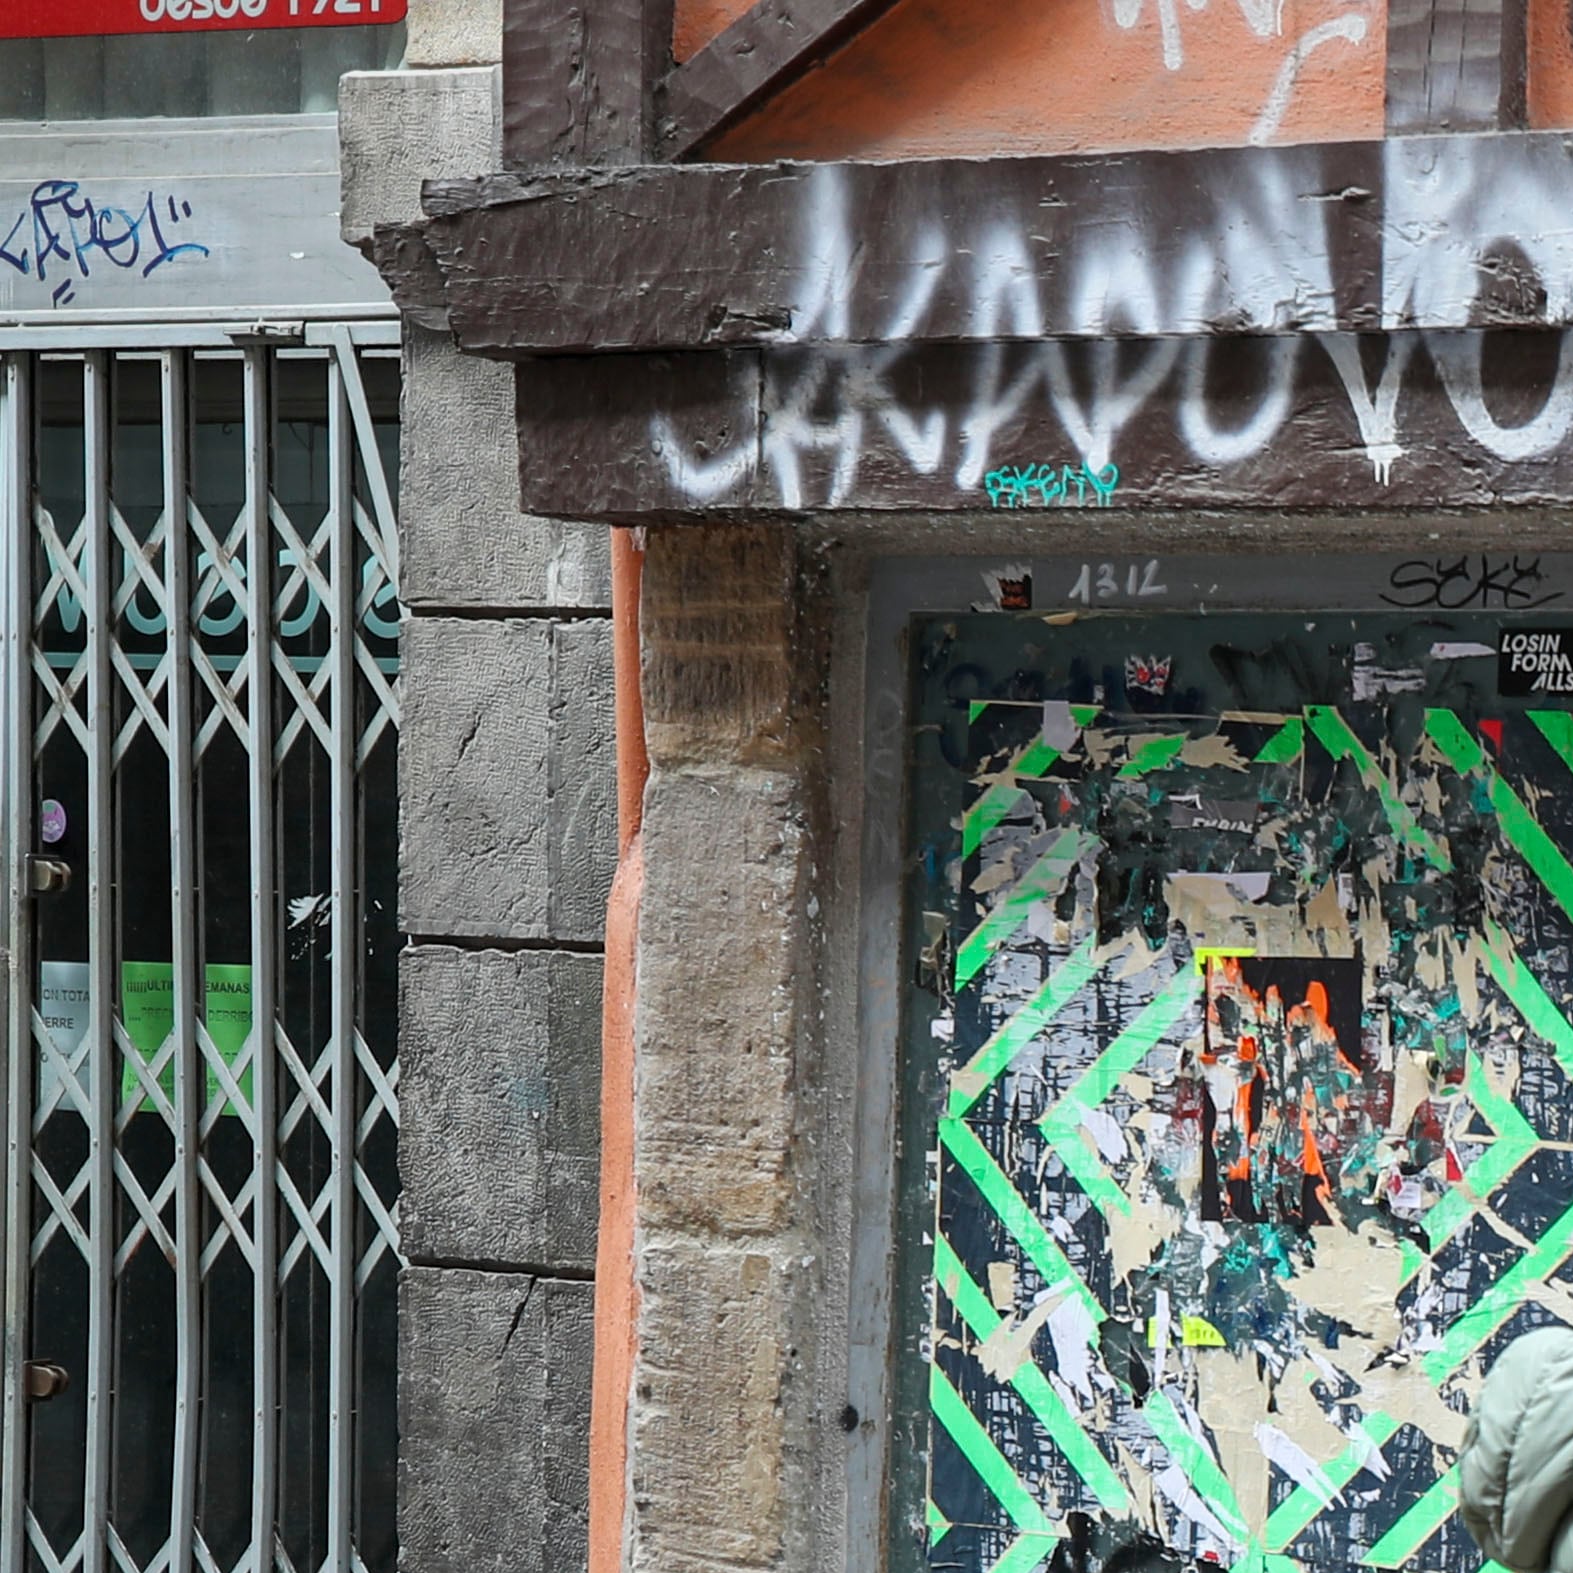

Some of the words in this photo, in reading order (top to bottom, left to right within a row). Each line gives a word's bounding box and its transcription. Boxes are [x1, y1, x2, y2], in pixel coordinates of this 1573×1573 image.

[1069, 560, 1167, 604] 1312
[1501, 634, 1561, 653] LOSIN
[1511, 653, 1573, 672] FORM
